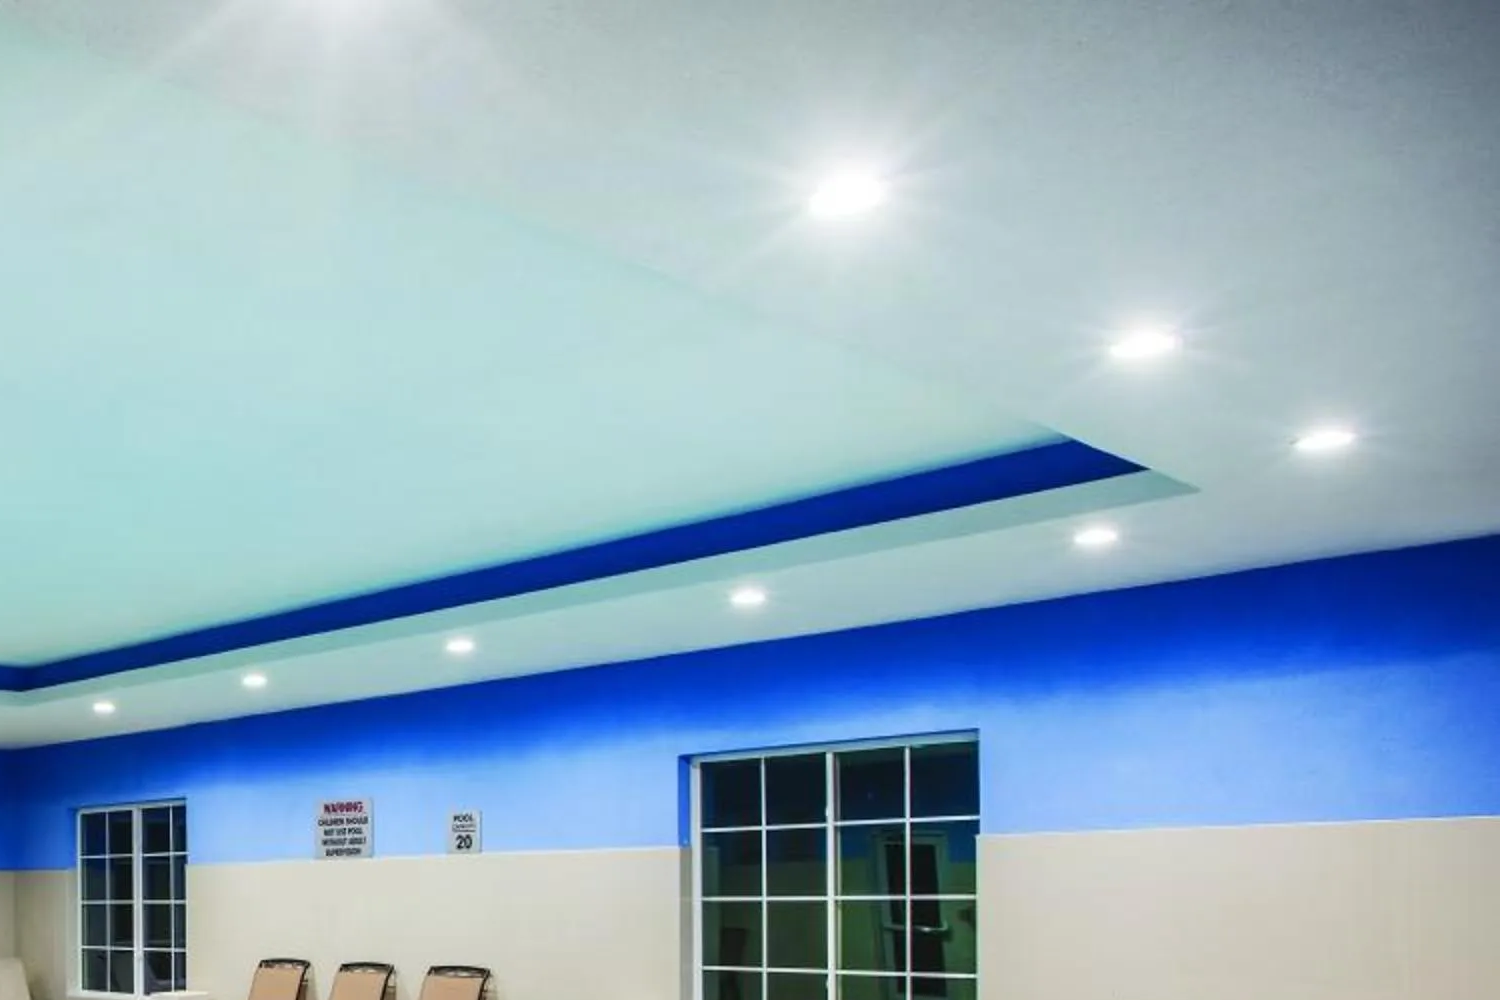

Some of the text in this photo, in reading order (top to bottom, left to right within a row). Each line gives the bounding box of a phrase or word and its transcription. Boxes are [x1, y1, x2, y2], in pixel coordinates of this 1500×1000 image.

[323, 801, 364, 813] WARNING
[453, 814, 473, 822] POOL
[455, 834, 473, 850] 20
